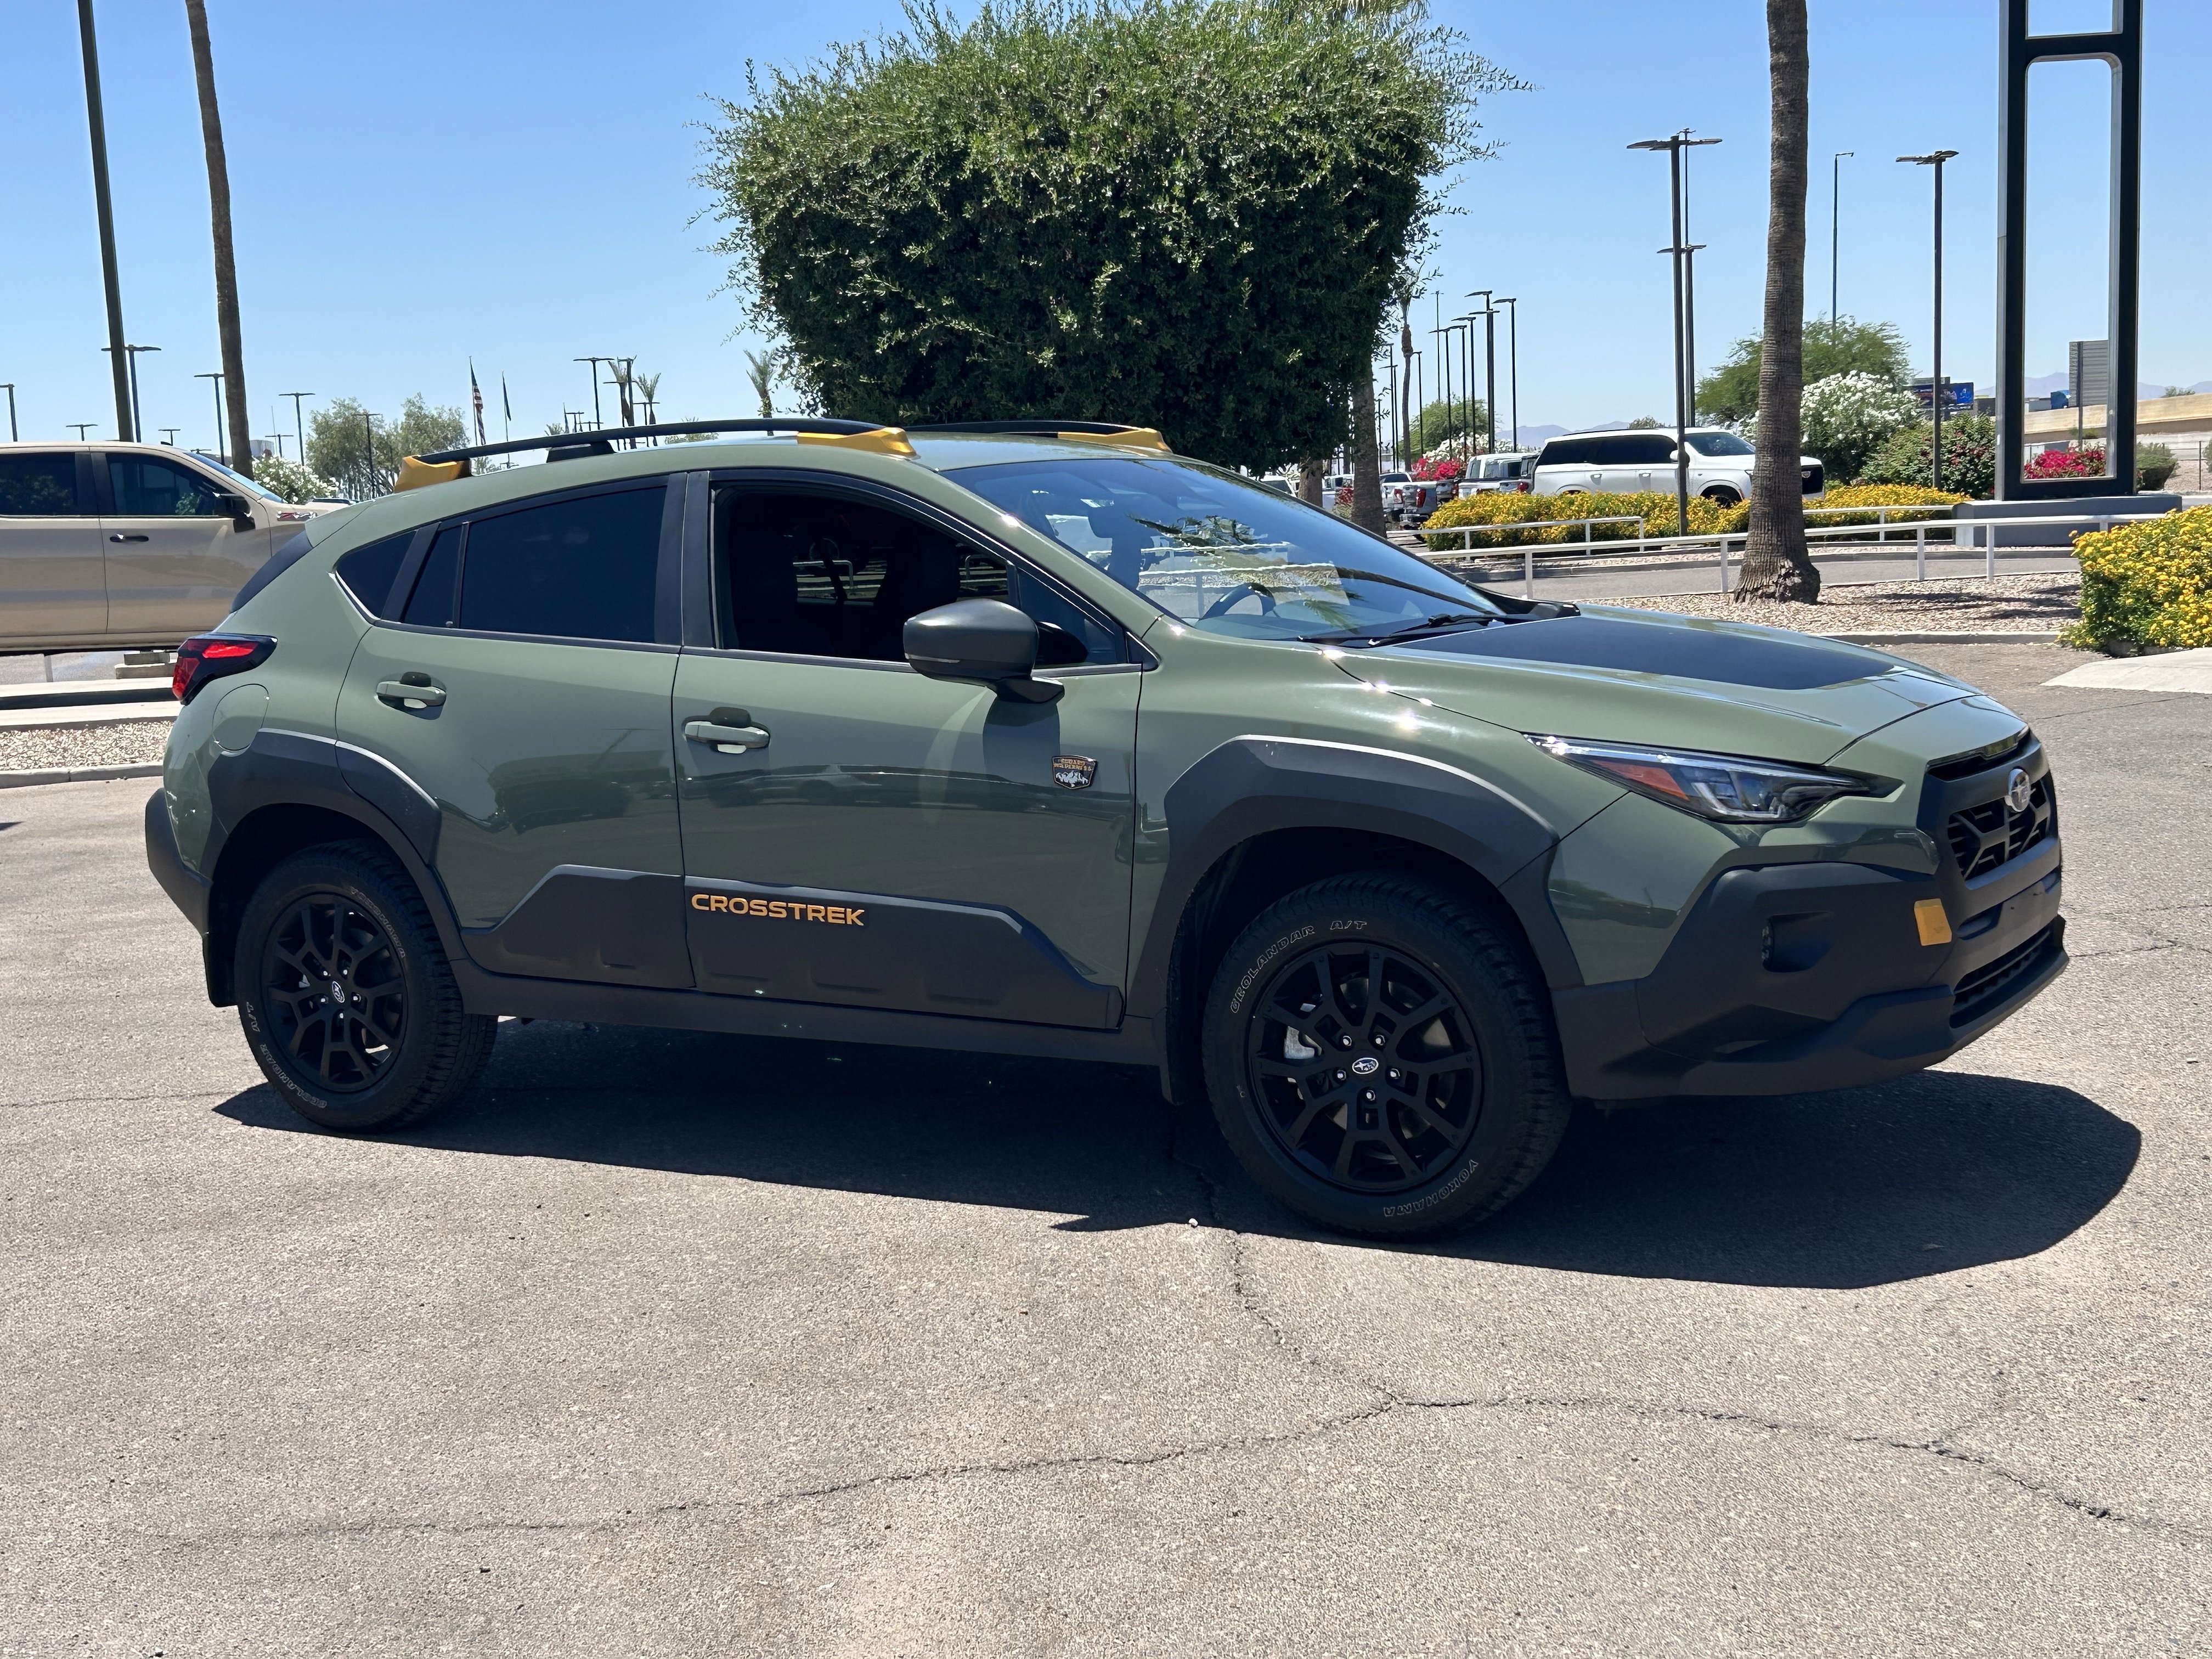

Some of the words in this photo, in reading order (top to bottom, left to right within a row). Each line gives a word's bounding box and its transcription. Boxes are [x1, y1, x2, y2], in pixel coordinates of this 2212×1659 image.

[691, 894, 865, 926] CROSSTREK
[1231, 926, 1316, 1013] GEOLANDAR
[1330, 920, 1367, 930] A/T
[1384, 1159, 1479, 1217] YOKOHAMA
